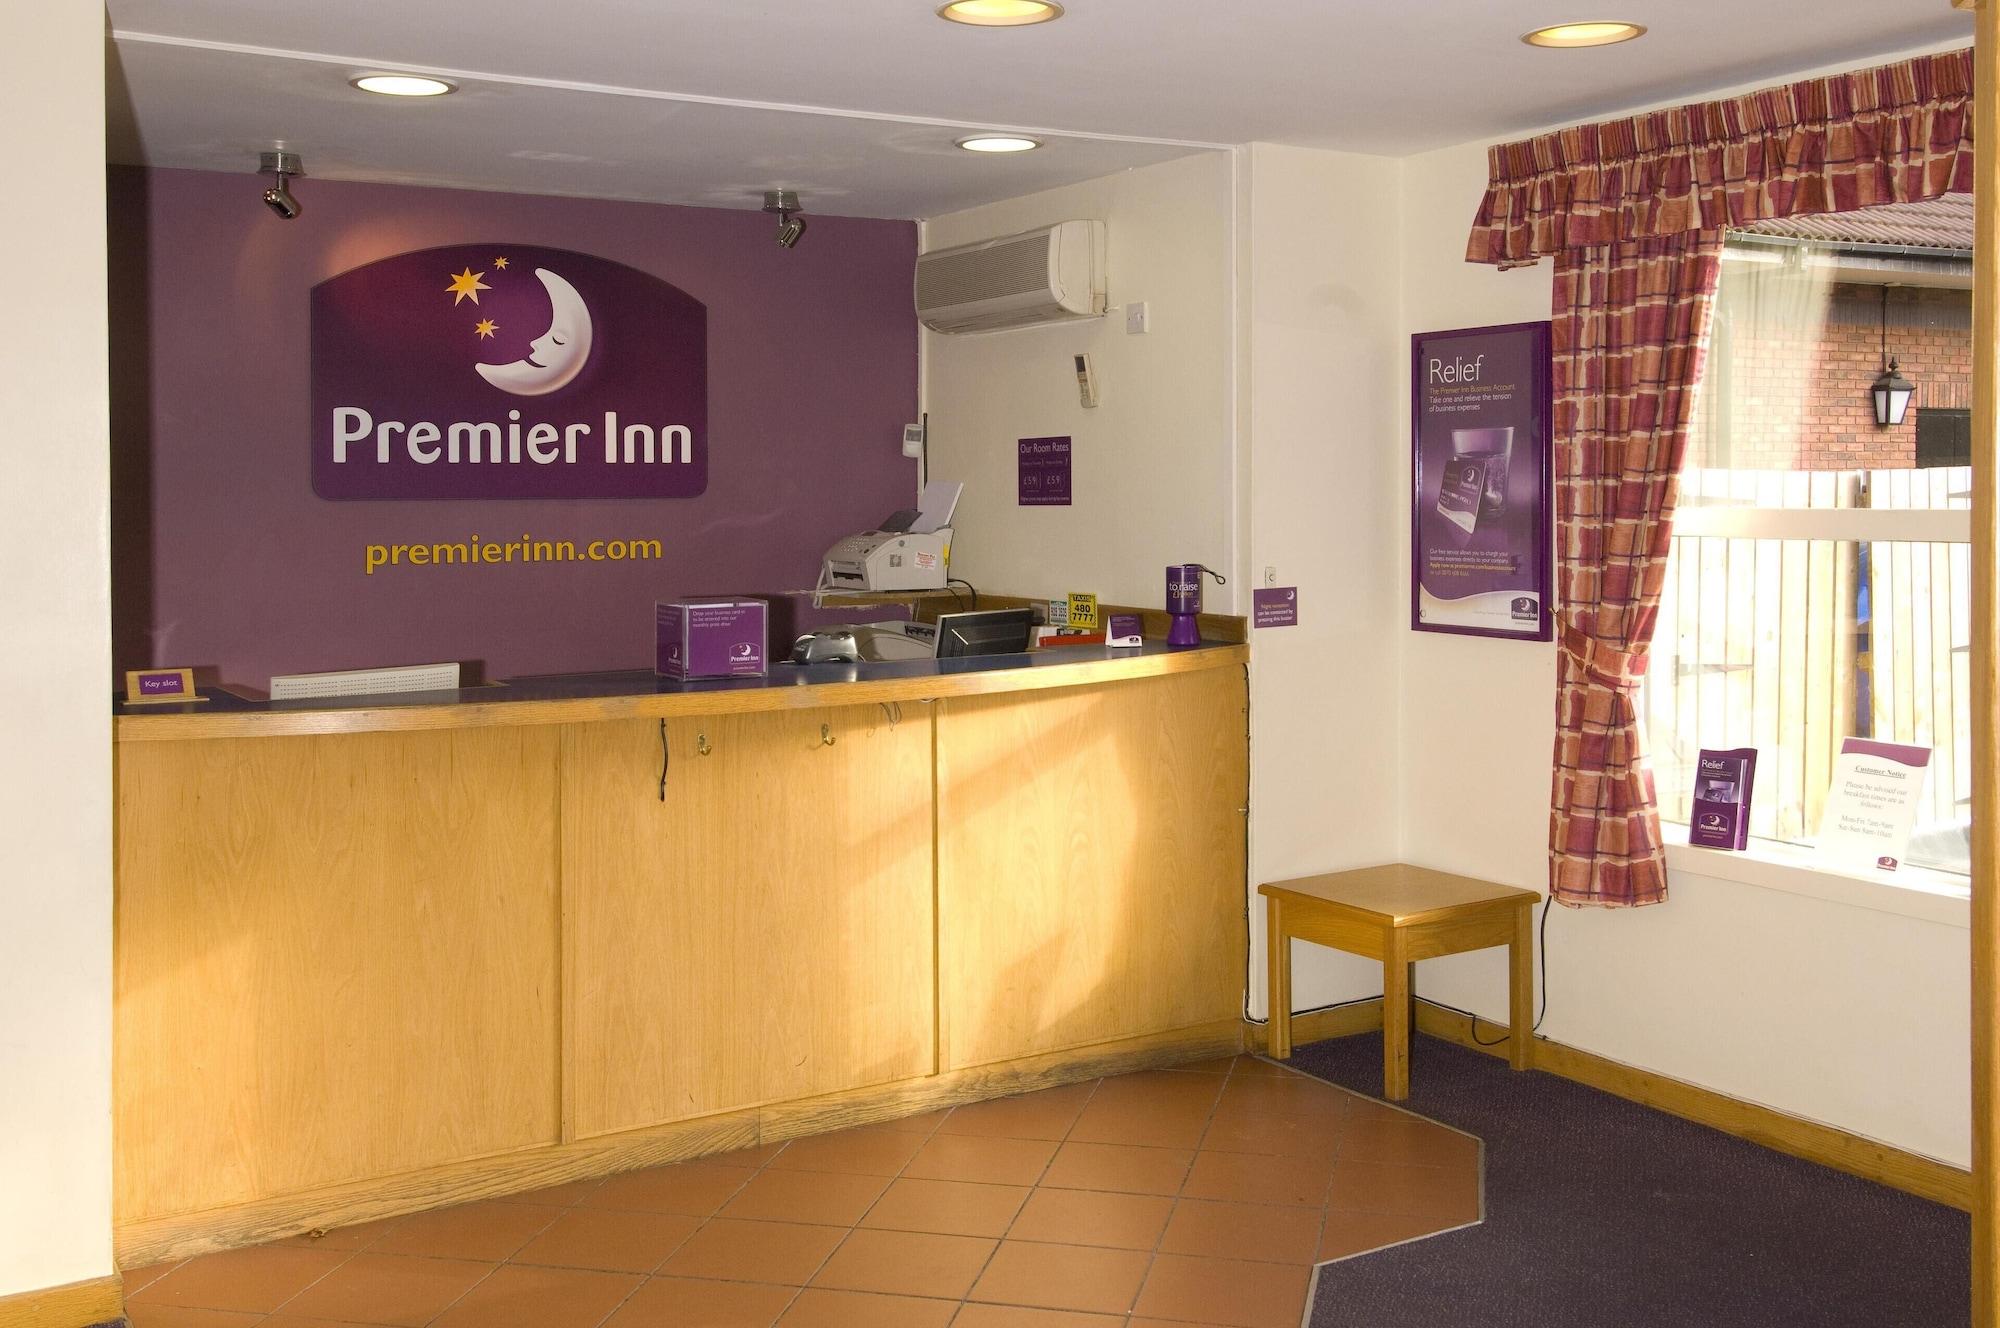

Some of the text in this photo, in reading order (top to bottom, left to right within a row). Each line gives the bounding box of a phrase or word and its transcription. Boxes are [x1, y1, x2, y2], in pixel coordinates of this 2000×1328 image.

[1430, 354, 1484, 384] Relief
[1440, 386, 1460, 394] Premier
[1470, 384, 1491, 392] Business
[1493, 383, 1515, 391] Account
[1465, 394, 1481, 402] relieve
[1482, 393, 1491, 401] the
[1492, 393, 1512, 401] tension
[1429, 404, 1480, 412] of business expenses
[333, 407, 692, 464] Premier Inn
[1020, 442, 1069, 453] Our Room Rates
[366, 534, 662, 575] premierinn.com
[1169, 581, 1199, 591] to raise
[1075, 605, 1090, 613] 480
[1072, 613, 1093, 622] 7777
[145, 680, 160, 688] Key
[1702, 760, 1725, 769] Relief
[1855, 765, 1907, 779] Customer Notice
[1846, 780, 1864, 789] Please
[1874, 785, 1896, 794] advised
[1844, 788, 1869, 798] breakfast
[1841, 815, 1864, 825] Mon-Fri
